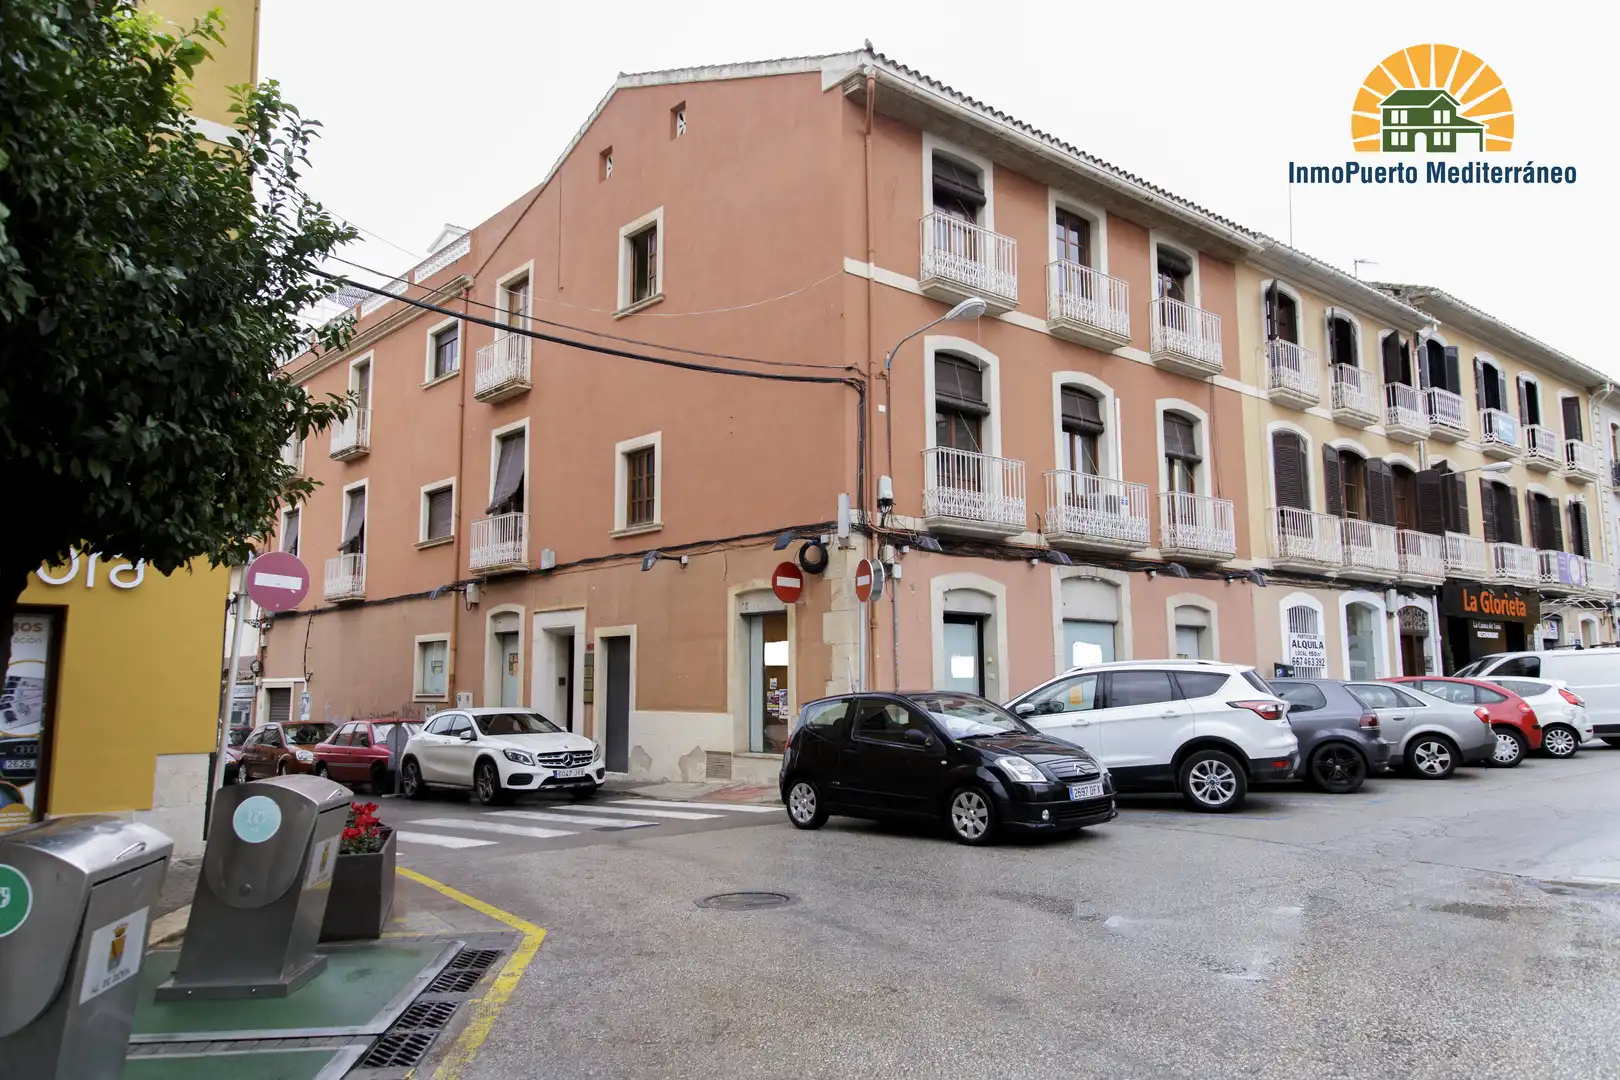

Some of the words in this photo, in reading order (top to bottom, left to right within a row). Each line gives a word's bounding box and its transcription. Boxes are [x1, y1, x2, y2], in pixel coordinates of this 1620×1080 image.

[1462, 588, 1478, 612] La
[1480, 591, 1527, 617] Glorieta
[1292, 640, 1324, 650] ALQUILA
[1074, 786, 1088, 798] 2697
